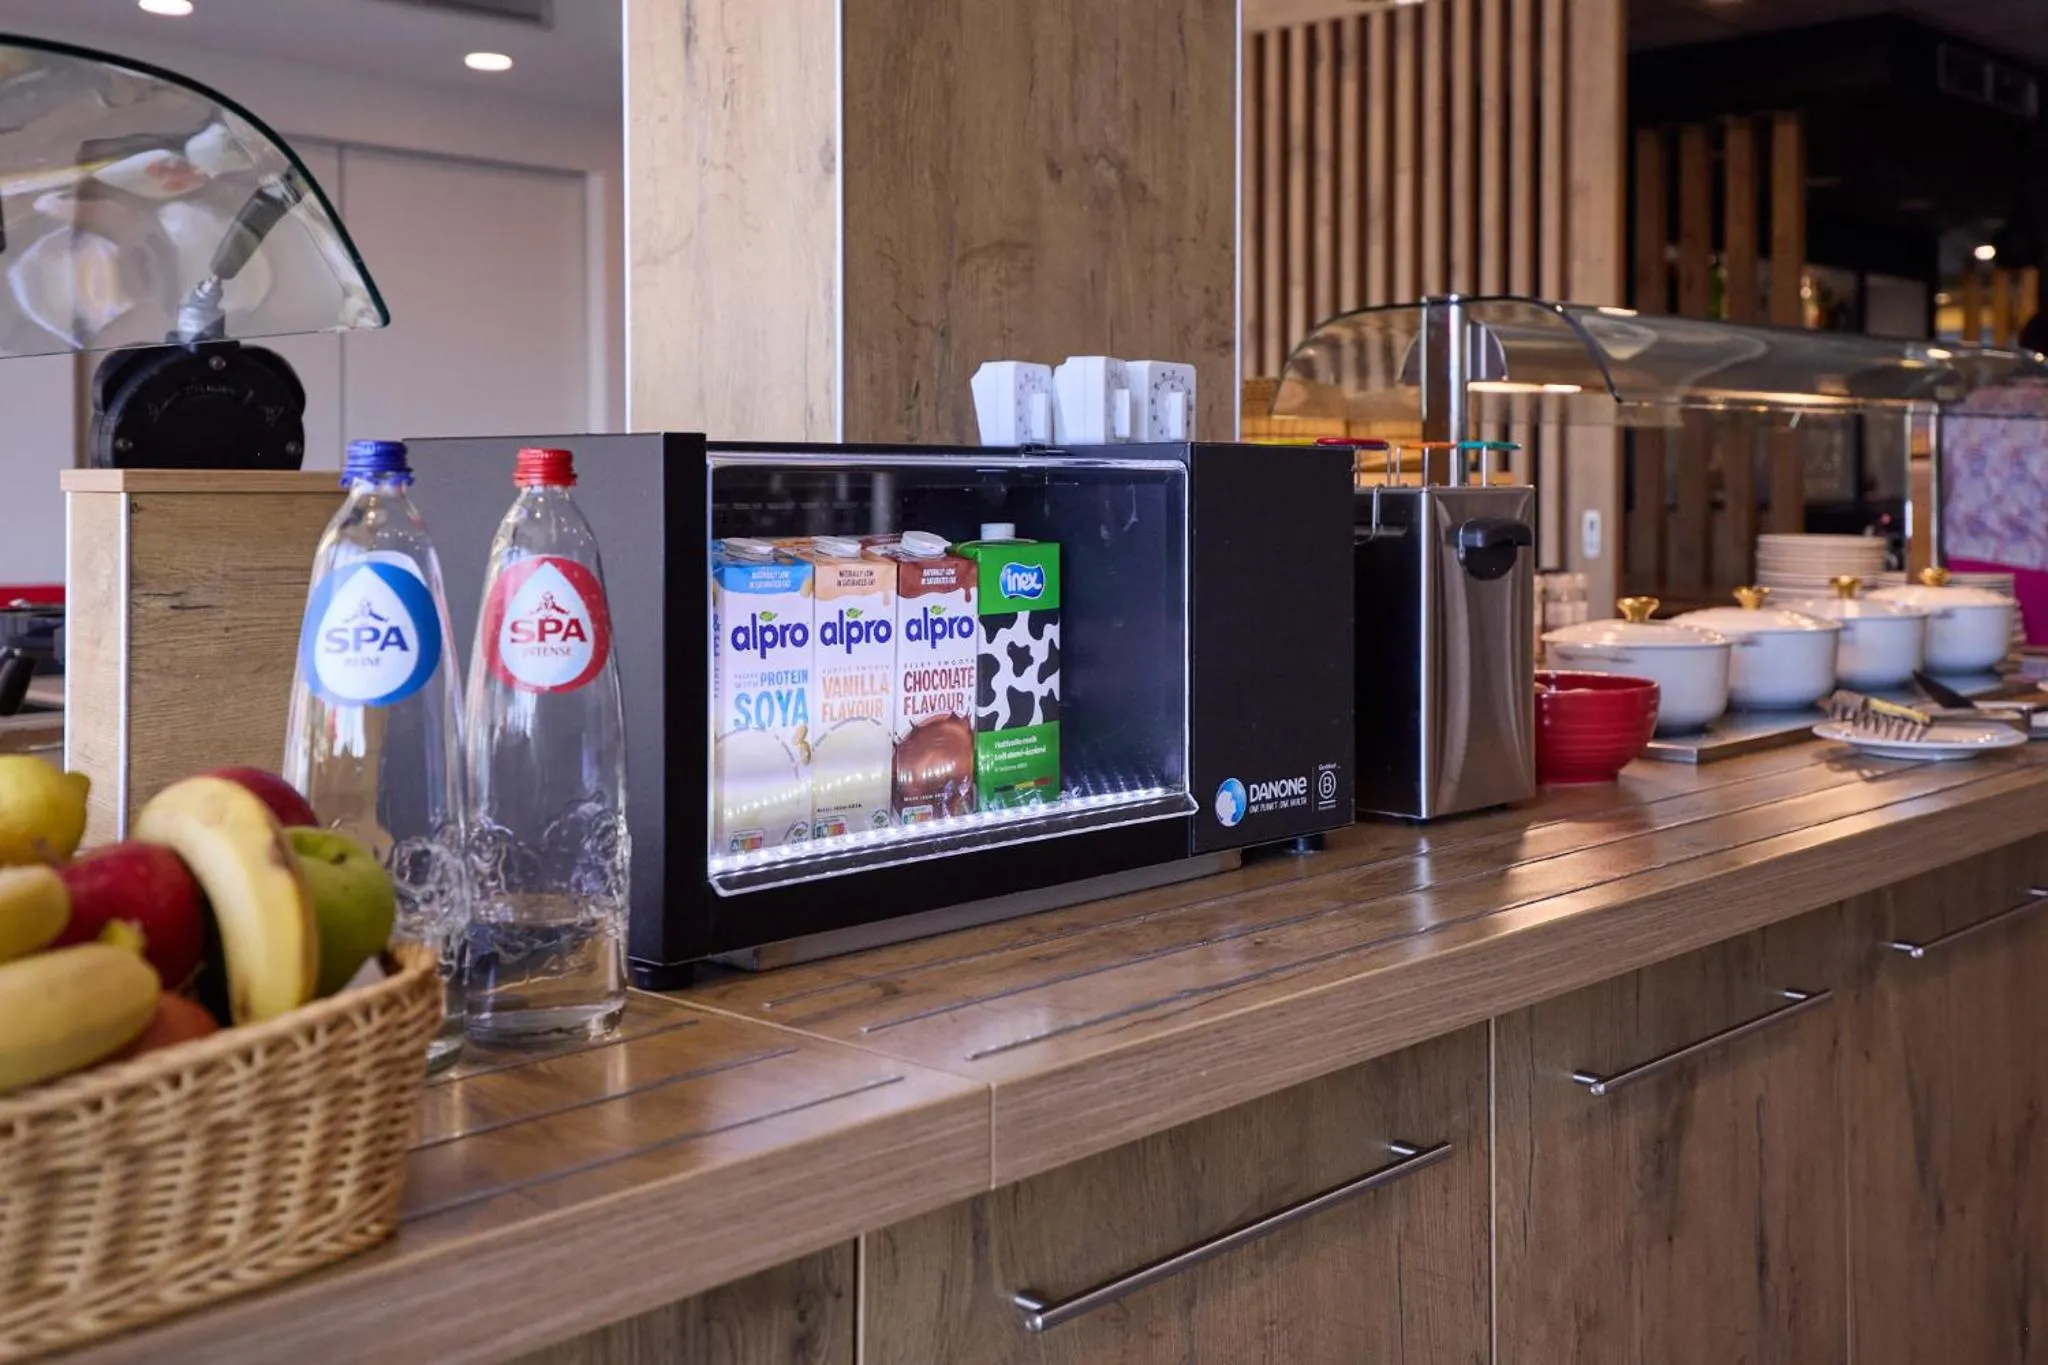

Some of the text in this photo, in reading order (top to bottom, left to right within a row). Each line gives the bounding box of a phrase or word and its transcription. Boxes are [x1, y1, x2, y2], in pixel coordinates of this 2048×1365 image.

[1006, 567, 1042, 592] inex
[324, 626, 410, 654] SPA
[509, 617, 588, 644] SPA
[730, 612, 809, 660] alpro
[820, 609, 892, 655] alpro
[905, 606, 975, 649] alpro
[760, 668, 808, 687] PROTEIN
[822, 673, 890, 699] VANILLA
[904, 666, 975, 693] CHOCOLATE
[733, 688, 808, 732] SOYA
[821, 699, 884, 722] FLAVOUR
[904, 692, 965, 716] FLAVOUR
